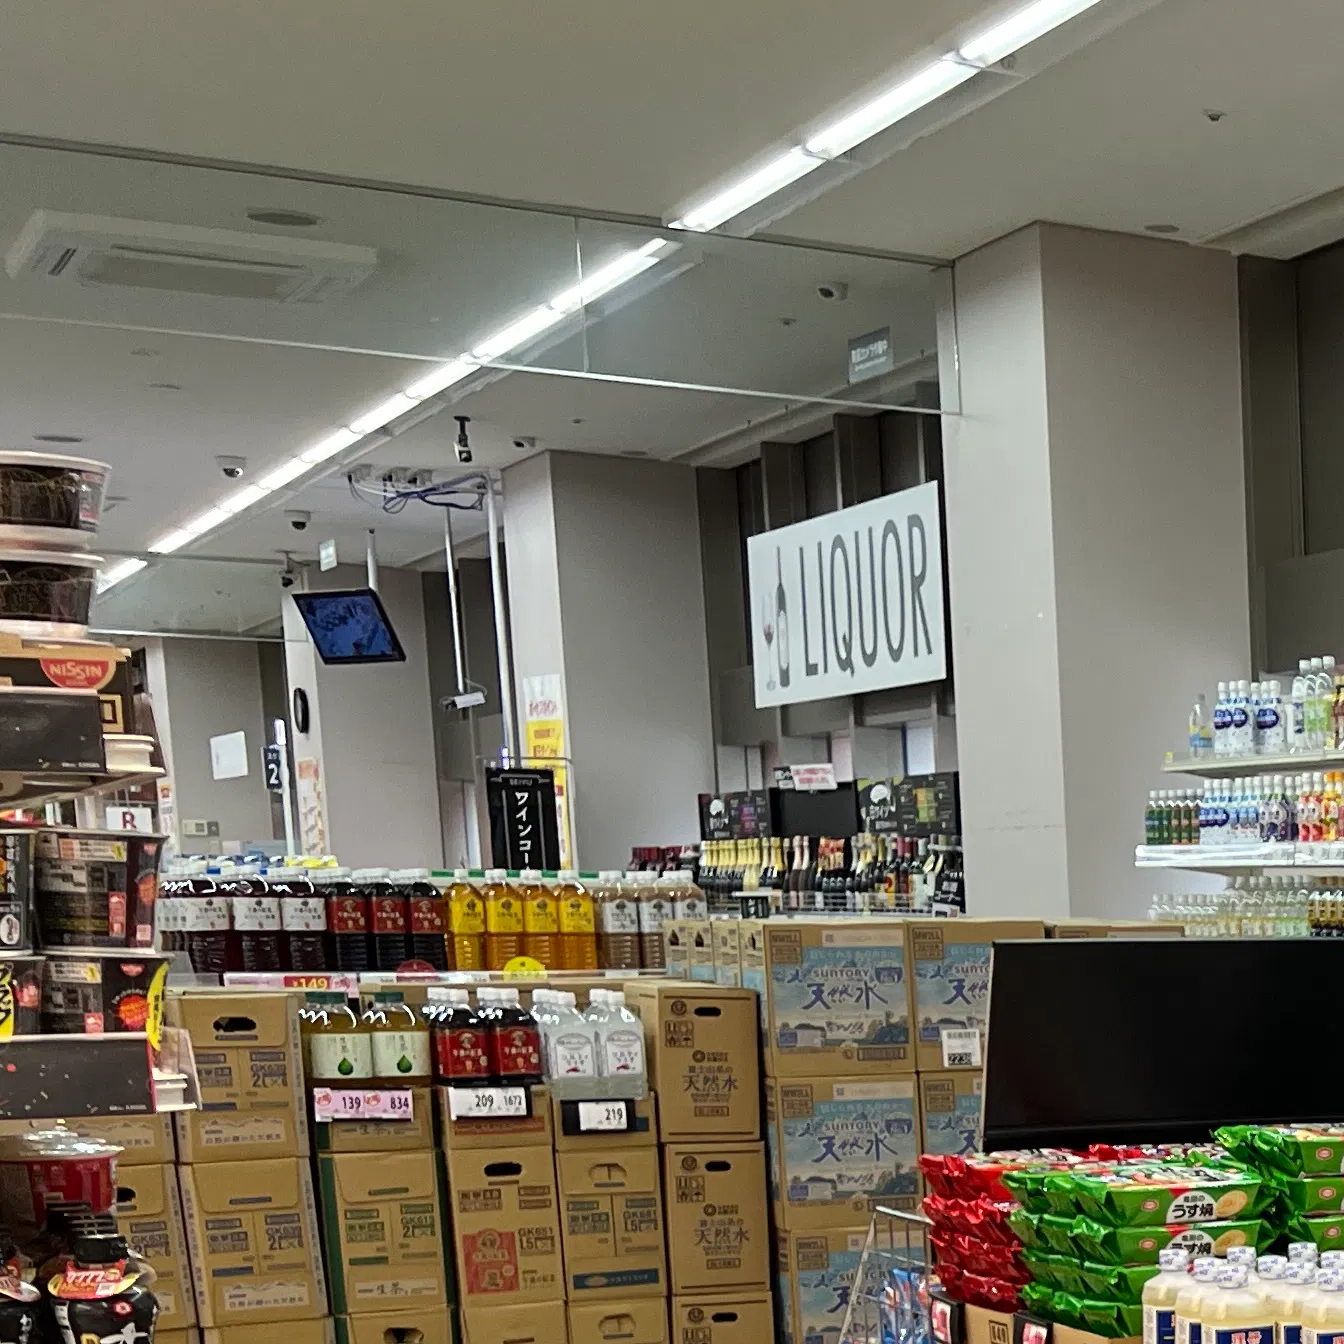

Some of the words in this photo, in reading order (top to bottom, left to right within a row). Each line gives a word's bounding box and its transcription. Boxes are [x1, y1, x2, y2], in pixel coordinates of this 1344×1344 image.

[799, 512, 933, 678] LIQUOR
[49, 661, 103, 681] NISSIN
[268, 763, 279, 785] 2
[514, 791, 533, 868] ワインコー
[812, 967, 870, 979] SUNTORY
[802, 980, 889, 1010] 天然水
[683, 1074, 738, 1093] 天然水
[342, 1096, 361, 1110] 139
[390, 1096, 409, 1110] 834
[475, 1094, 494, 1108] 209
[605, 1108, 623, 1120] 219
[824, 1120, 880, 1131] SUNTORY
[812, 1133, 898, 1162] 天然水
[1171, 1203, 1214, 1219] うす焼
[695, 1225, 749, 1247] 天然水
